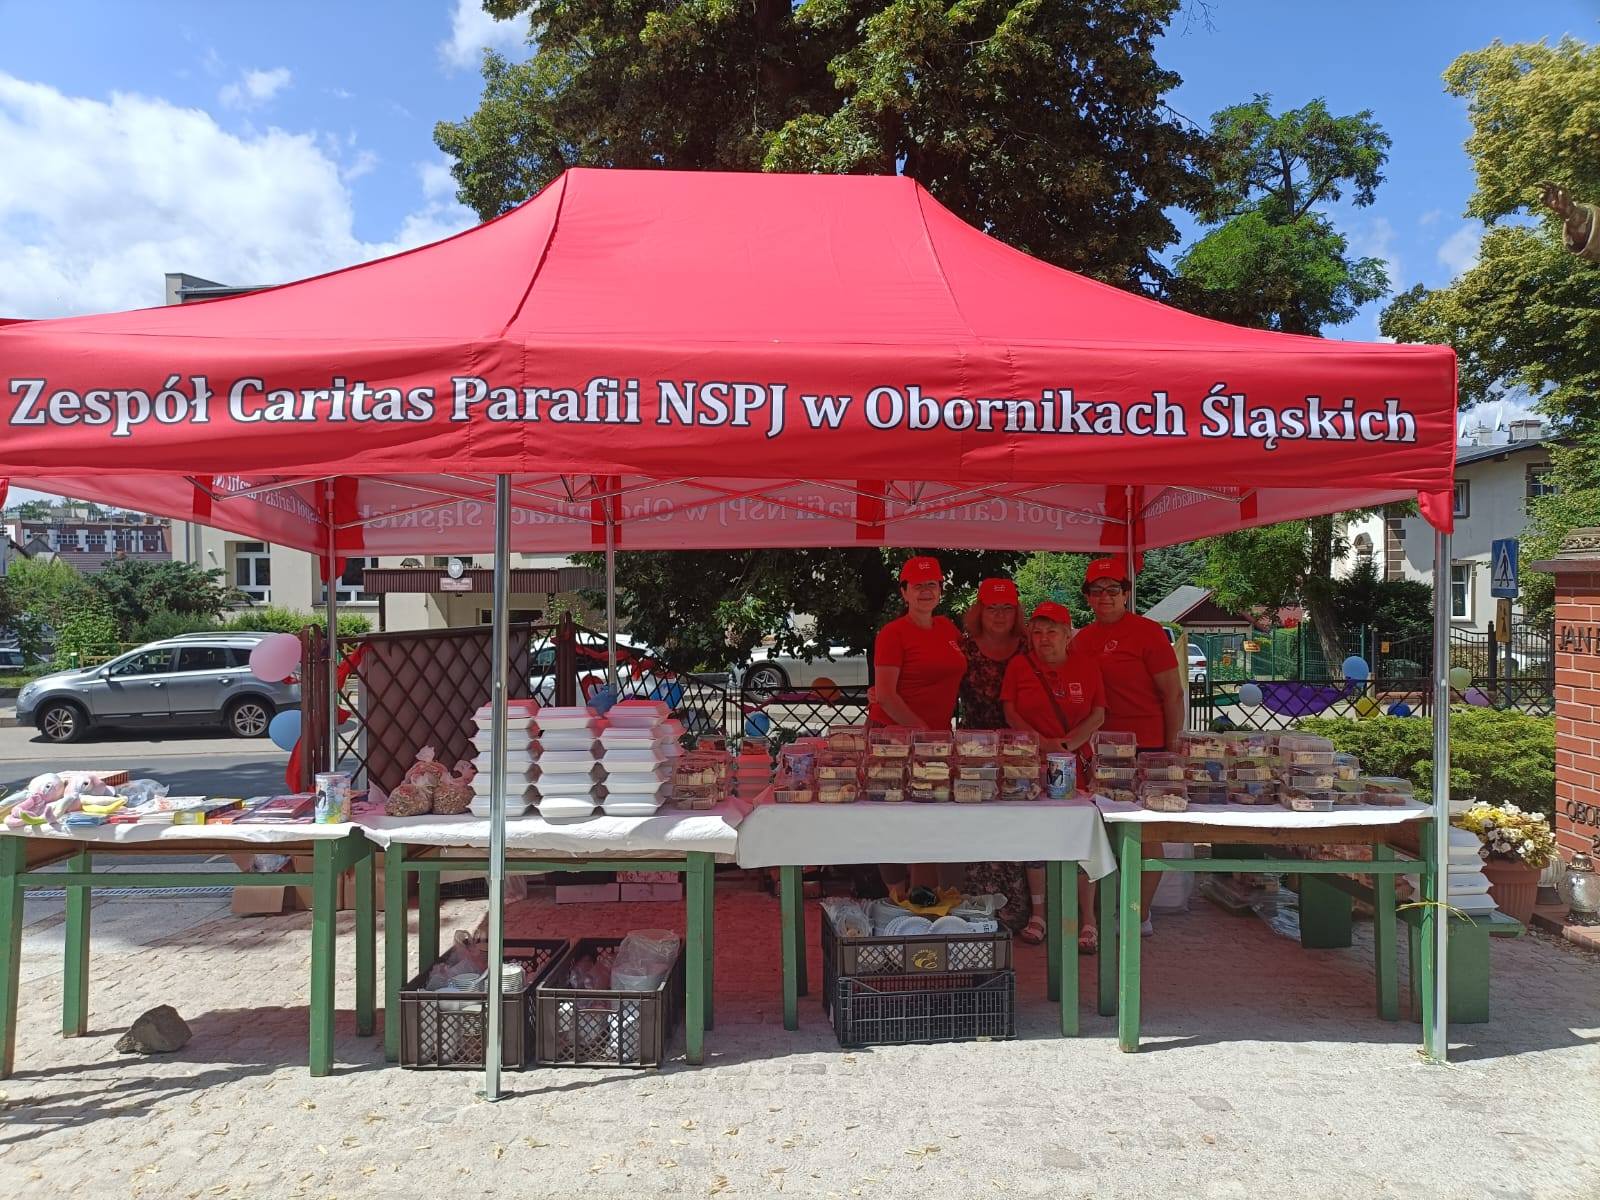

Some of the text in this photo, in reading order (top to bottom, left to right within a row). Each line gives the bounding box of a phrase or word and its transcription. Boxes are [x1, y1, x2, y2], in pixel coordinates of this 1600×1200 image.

[9, 375, 1416, 450] Zespół Caritas Parafii NSPJ w Obornikach Śląskich
[1558, 625, 1592, 653] JAN
